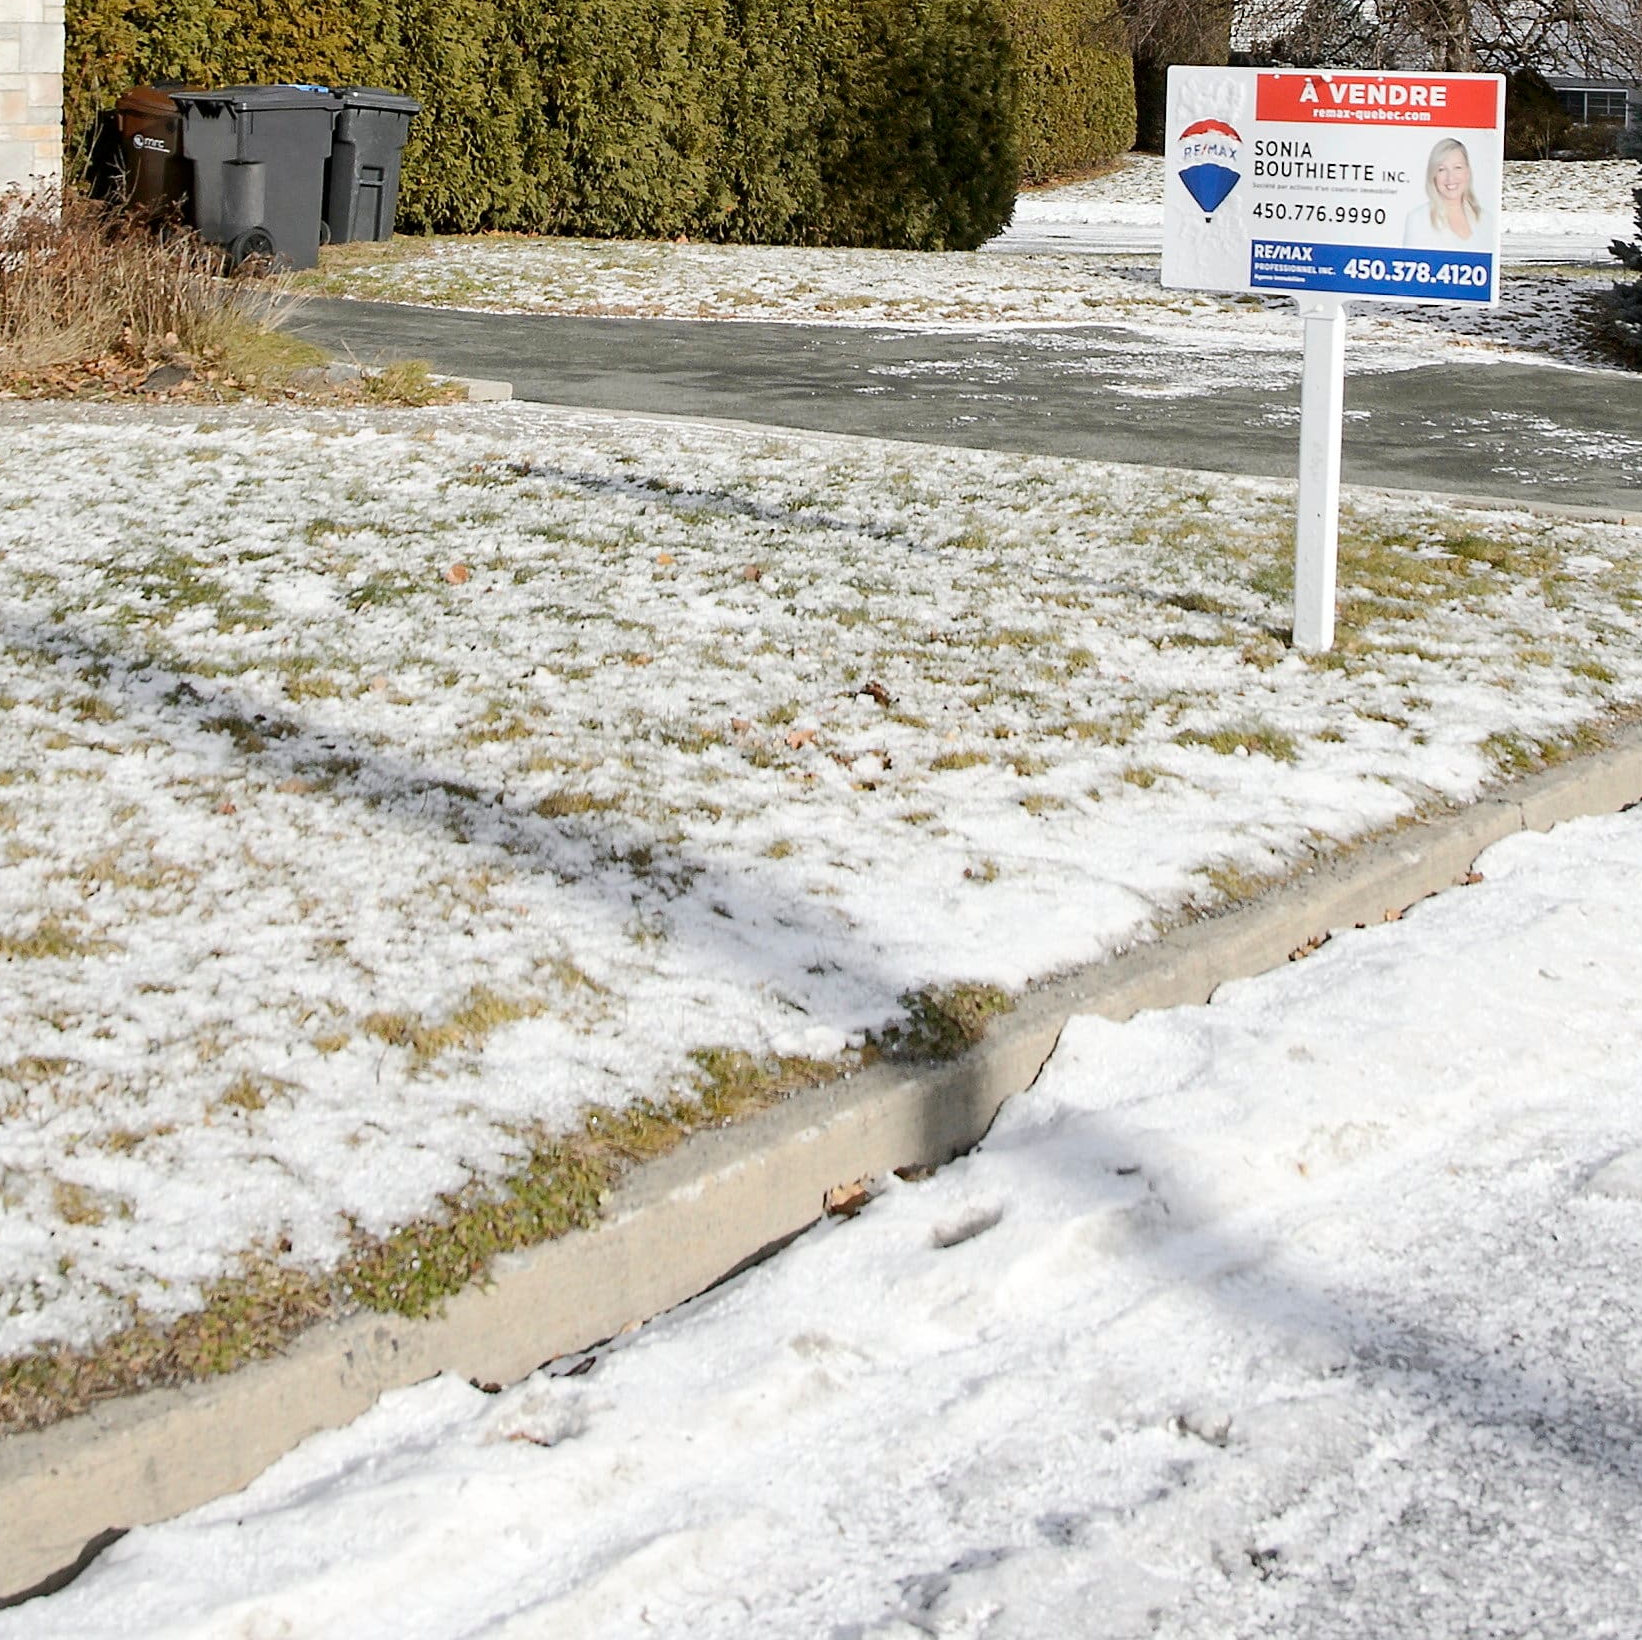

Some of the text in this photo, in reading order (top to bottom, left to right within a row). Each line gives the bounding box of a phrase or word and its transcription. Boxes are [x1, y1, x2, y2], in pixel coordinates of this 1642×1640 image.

[1328, 83, 1447, 107] VENDRE
[1312, 108, 1432, 122] remax-quebec.com
[1184, 144, 1237, 161] RE/MAX
[1254, 140, 1312, 159] SONIA
[1254, 161, 1411, 184] BOUTHIETTE INC.
[1252, 202, 1387, 225] 450.776.9990
[1254, 243, 1313, 262] RE/MAX
[1343, 258, 1488, 287] 450.378.4120
